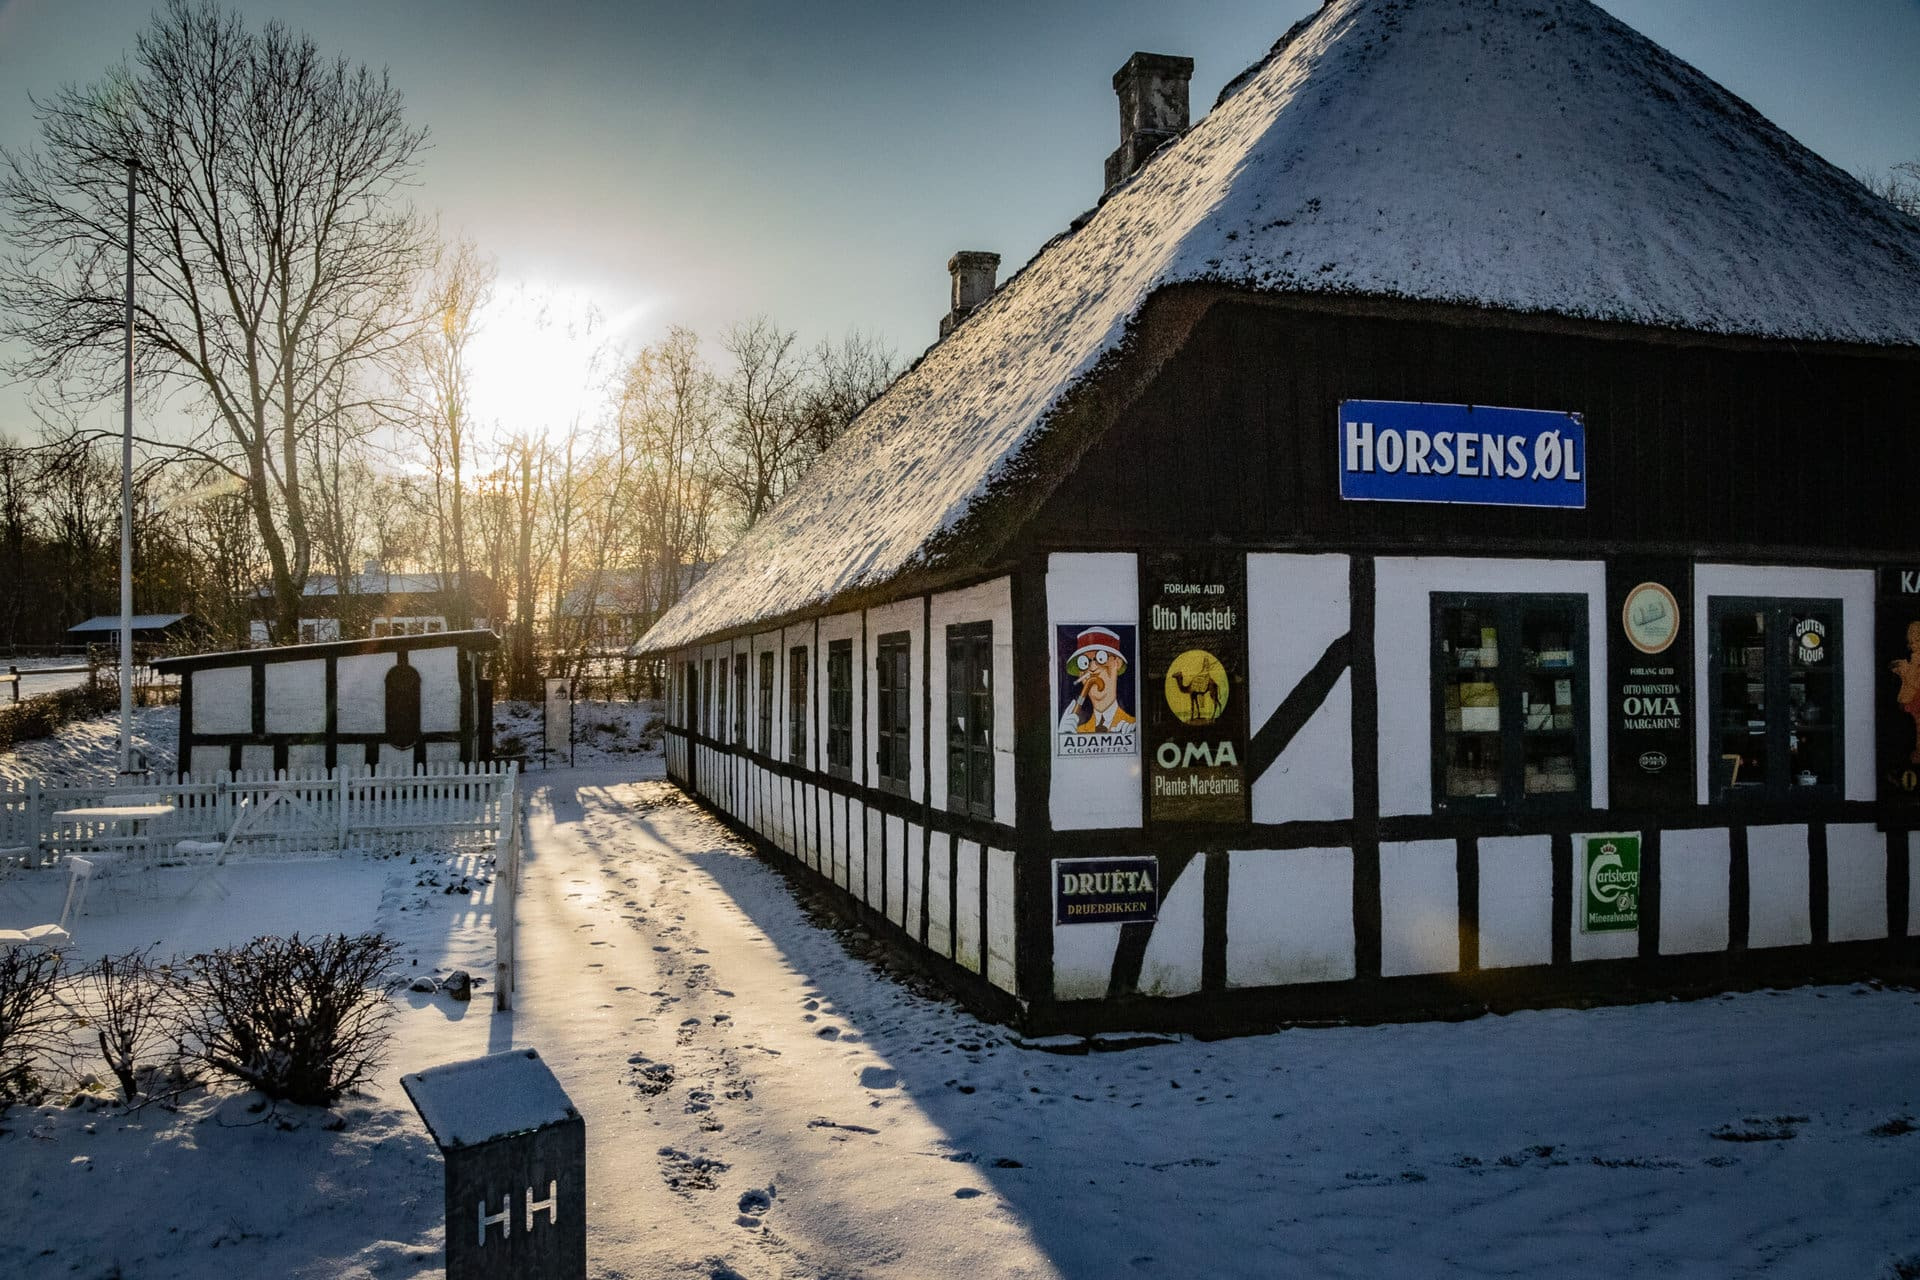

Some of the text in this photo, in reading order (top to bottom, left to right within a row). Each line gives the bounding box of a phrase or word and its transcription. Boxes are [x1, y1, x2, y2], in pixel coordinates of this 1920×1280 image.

[1346, 422, 1580, 480] HORSENS ØL
[1163, 583, 1225, 595] FORLANG ALTID
[1152, 604, 1177, 631] Otto
[1795, 618, 1825, 638] GLUTEN
[1798, 645, 1825, 662] FLOUR
[1623, 684, 1641, 695] OTTO
[1623, 696, 1682, 716] OMA
[1623, 717, 1681, 730] MARGARINE
[1063, 734, 1133, 747] ADAMAS
[1067, 746, 1129, 754] CIGARETTES
[1156, 740, 1238, 768] OMA
[1589, 853, 1638, 903] Carlsberg
[1067, 901, 1147, 915] DRUEDRIKKEN
